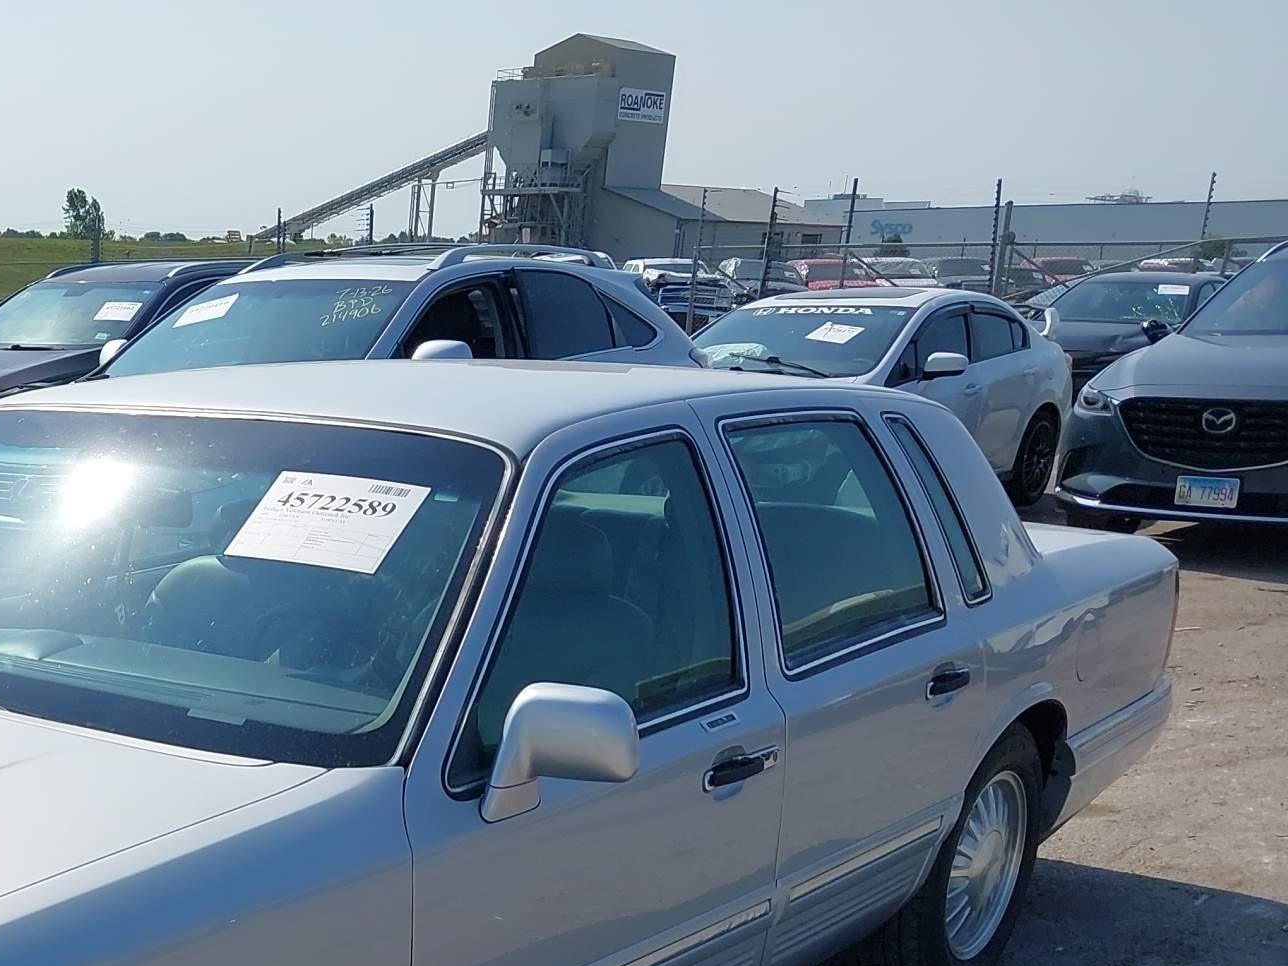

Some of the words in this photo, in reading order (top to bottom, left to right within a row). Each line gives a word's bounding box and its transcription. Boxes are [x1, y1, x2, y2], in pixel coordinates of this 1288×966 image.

[620, 94, 665, 110] ROANOKE
[775, 306, 873, 316] HONDA
[277, 491, 397, 518] 45722589
